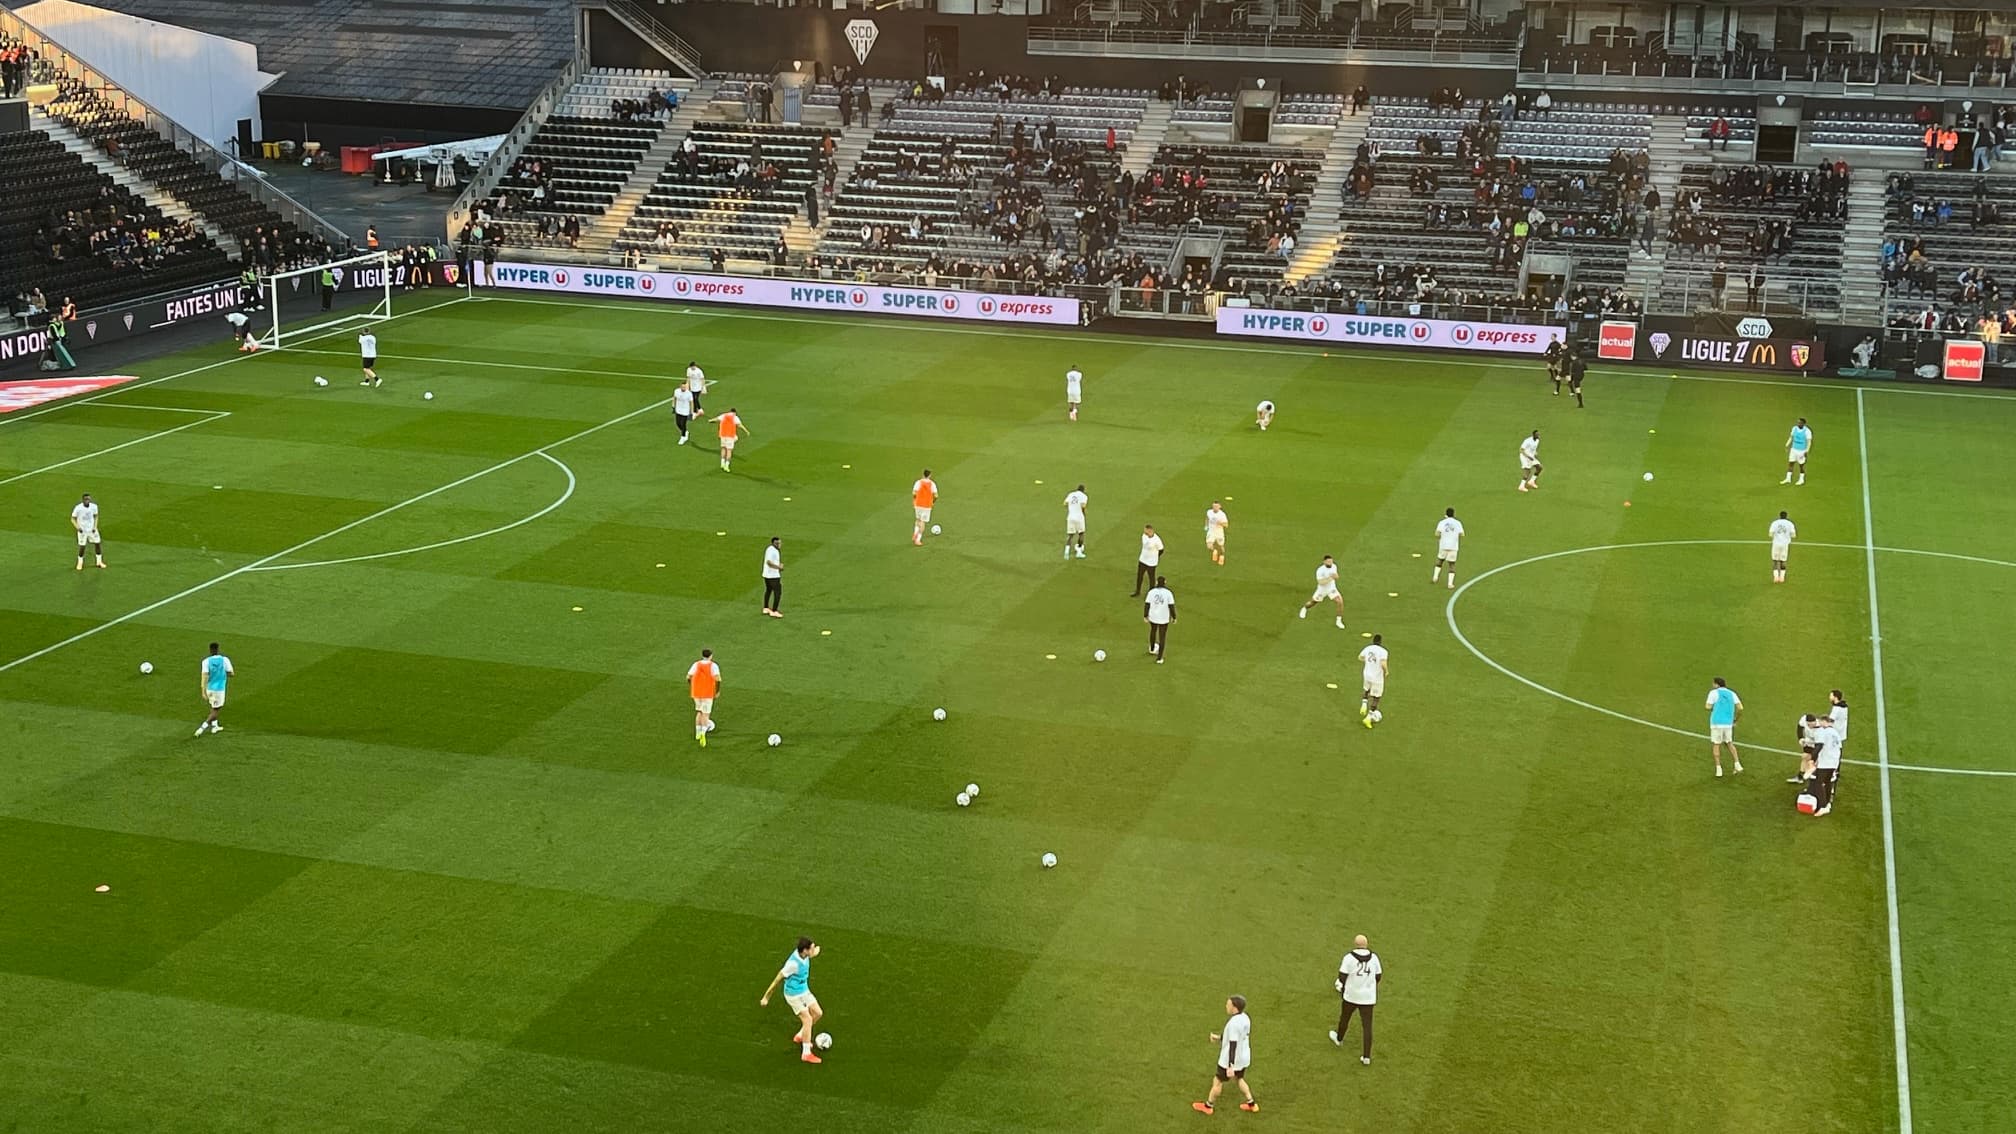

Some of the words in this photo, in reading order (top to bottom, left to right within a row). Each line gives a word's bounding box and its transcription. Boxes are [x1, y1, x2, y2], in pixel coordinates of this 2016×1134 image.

[851, 25, 872, 39] SCO
[354, 268, 393, 288] LIGUE
[497, 267, 549, 284] HYPER
[583, 273, 635, 290] SUPER
[694, 281, 744, 296] express
[790, 287, 847, 304] HYPER
[166, 293, 212, 320] FAITES
[215, 288, 234, 309] UN
[882, 292, 938, 309] SUPER
[1000, 302, 1053, 316] express
[1243, 314, 1305, 332] HYPER
[1345, 320, 1407, 338] SUPER
[1742, 323, 1766, 336] SCO
[1476, 330, 1537, 344] express
[1601, 337, 1633, 347] actual
[1681, 338, 1732, 362] LIGUE
[1948, 358, 1982, 369] actual
[1356, 961, 1371, 977] 24
